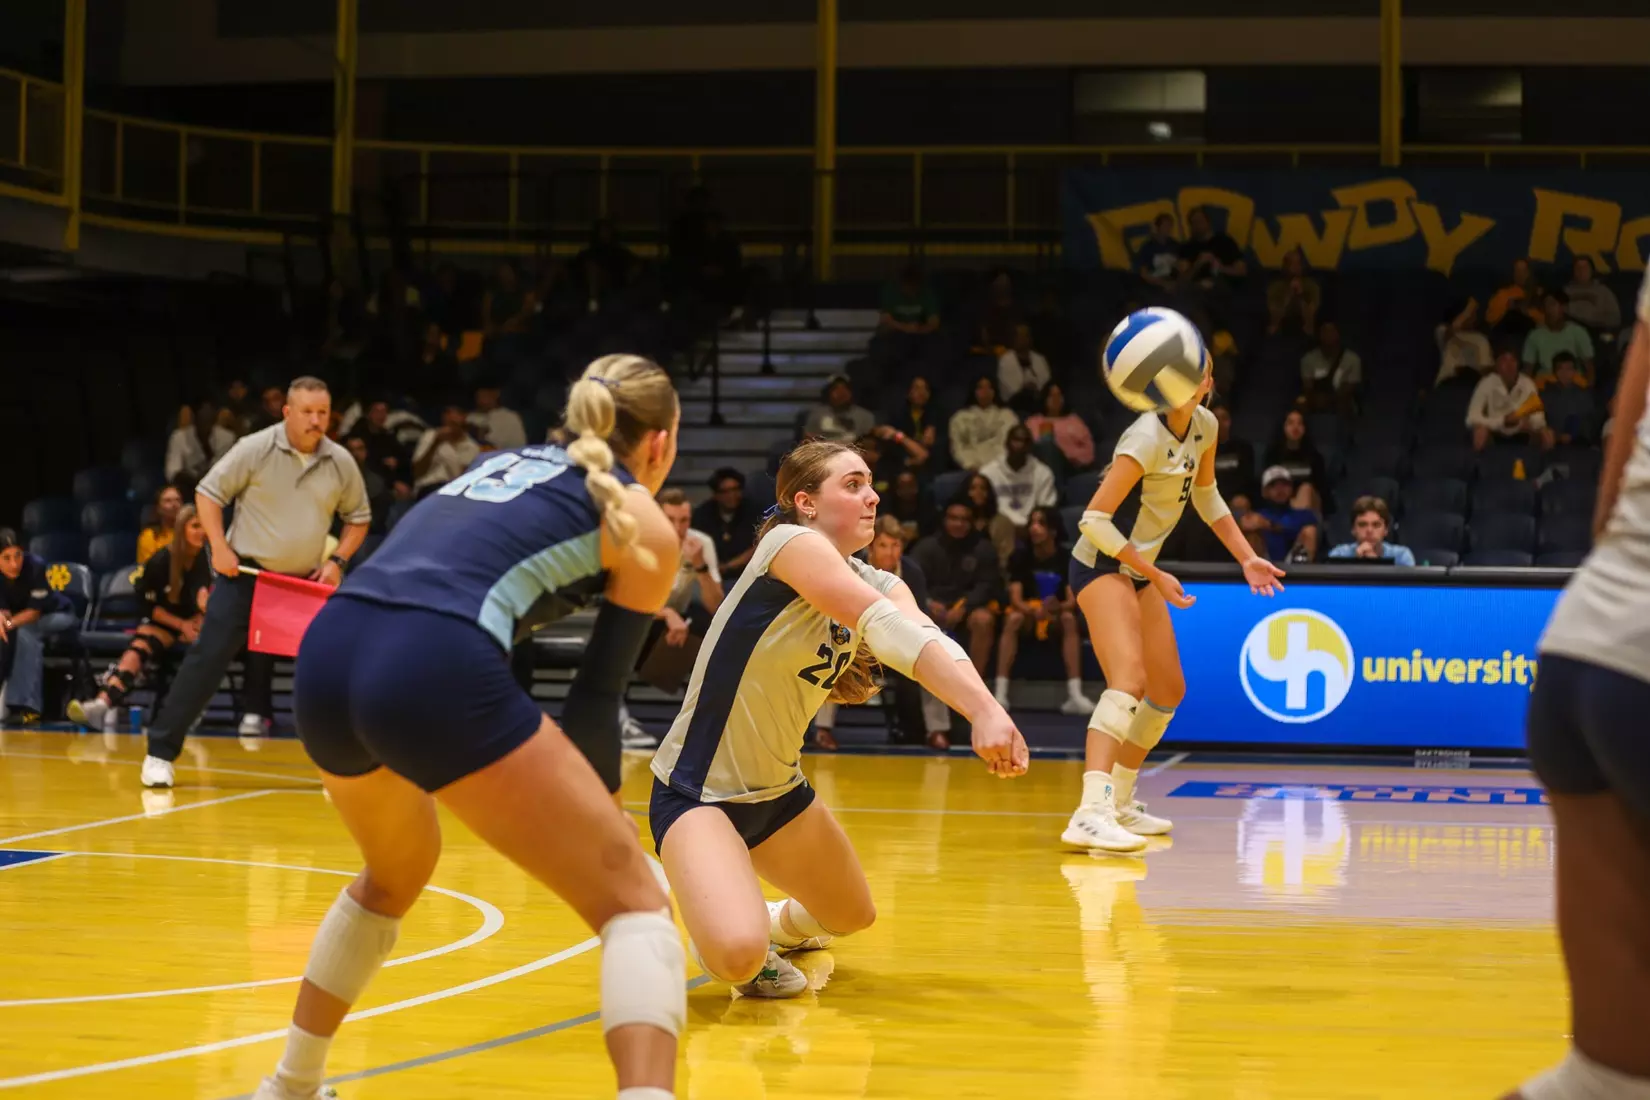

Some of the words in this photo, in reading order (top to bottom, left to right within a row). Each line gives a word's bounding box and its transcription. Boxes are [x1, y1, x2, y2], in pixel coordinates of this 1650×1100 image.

[437, 452, 569, 503] 13
[1178, 475, 1193, 503] 9
[797, 642, 852, 690] 20
[1362, 648, 1538, 693] university
